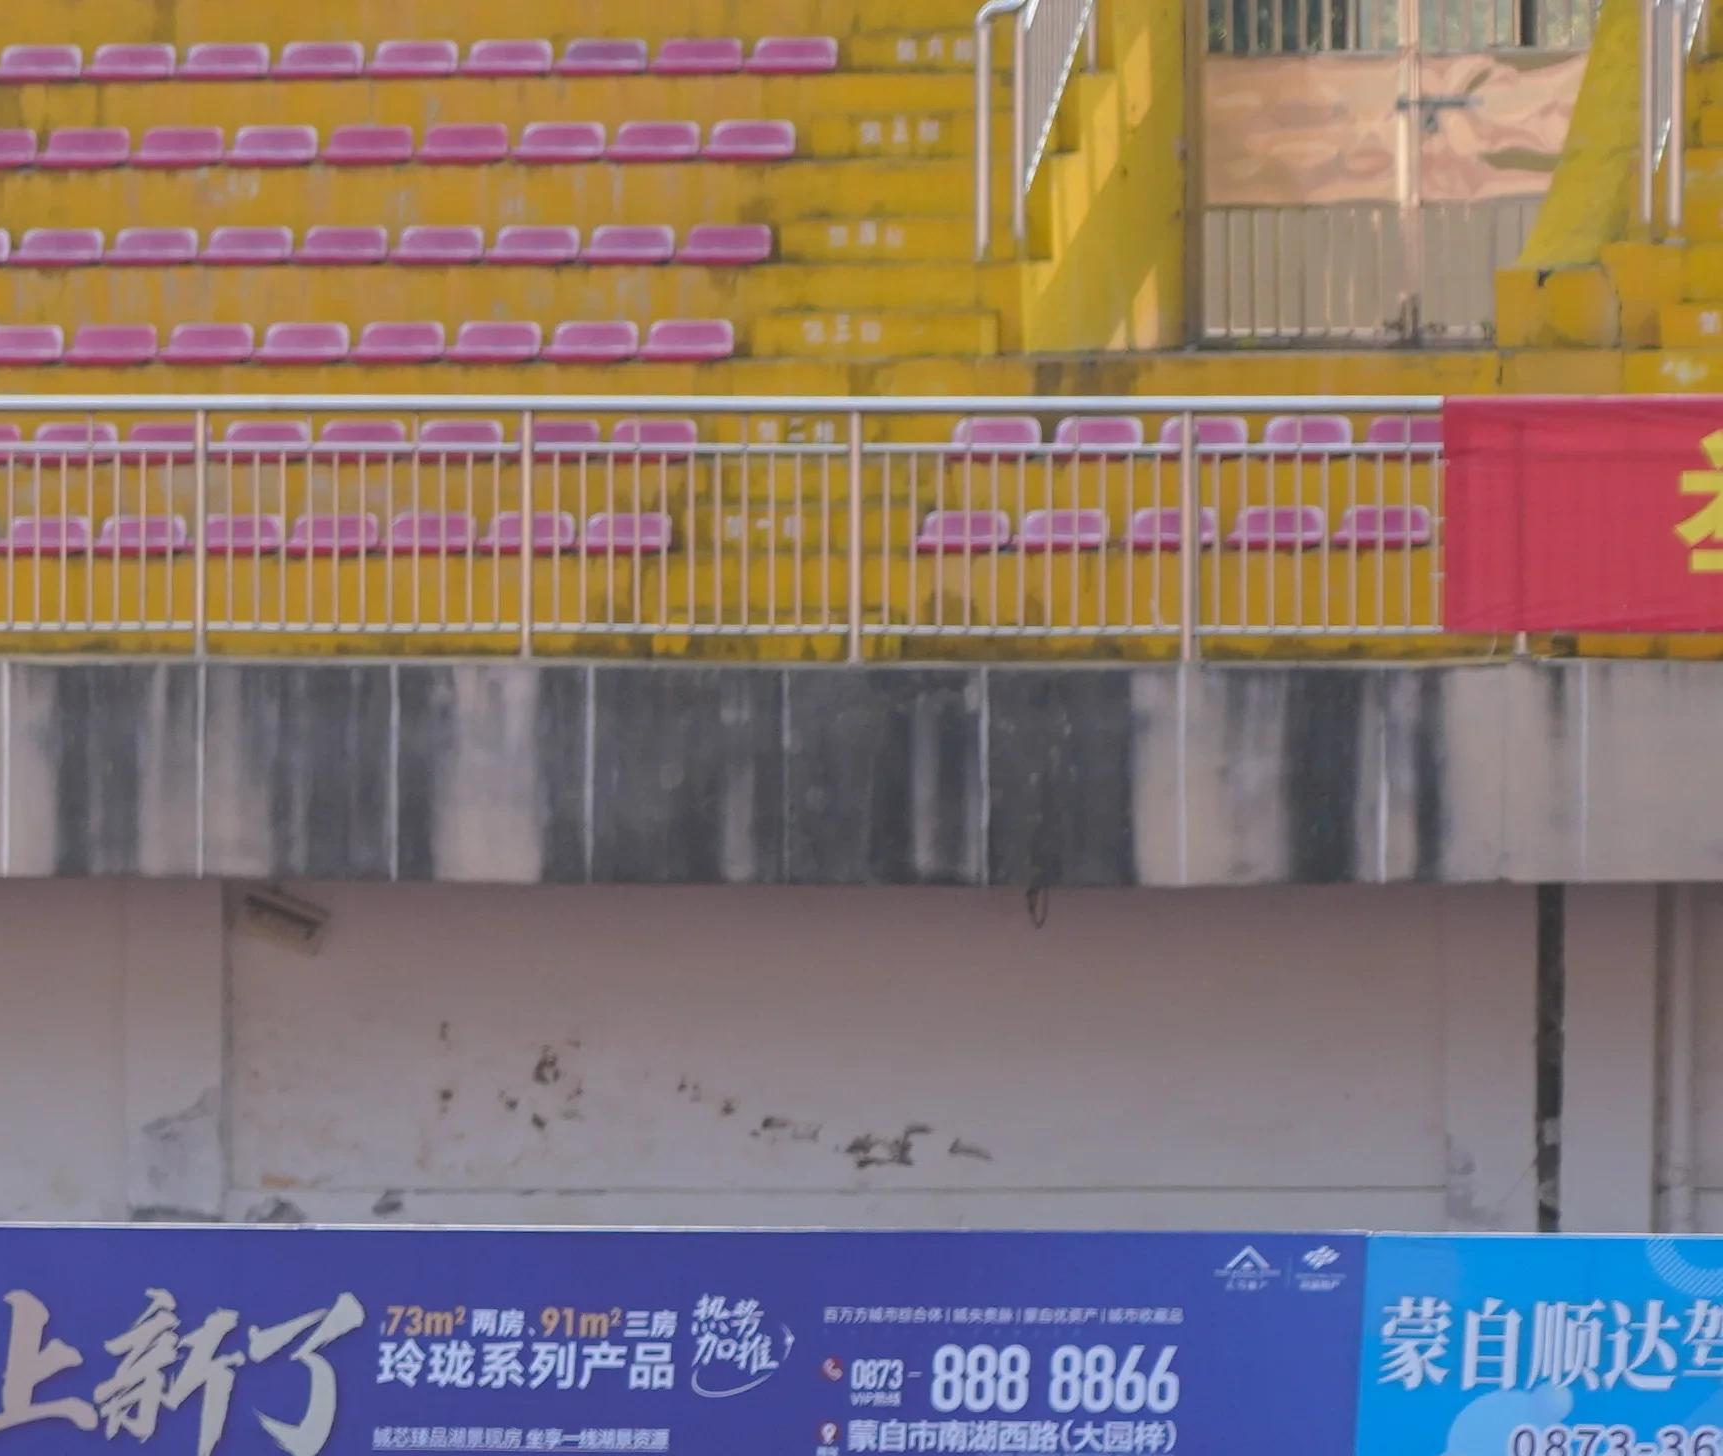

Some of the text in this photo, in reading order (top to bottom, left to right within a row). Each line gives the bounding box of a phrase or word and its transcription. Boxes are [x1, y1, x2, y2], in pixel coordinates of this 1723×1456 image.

[375, 1339, 676, 1390] 玲珑系列产品
[1048, 1344, 1181, 1414] 8866
